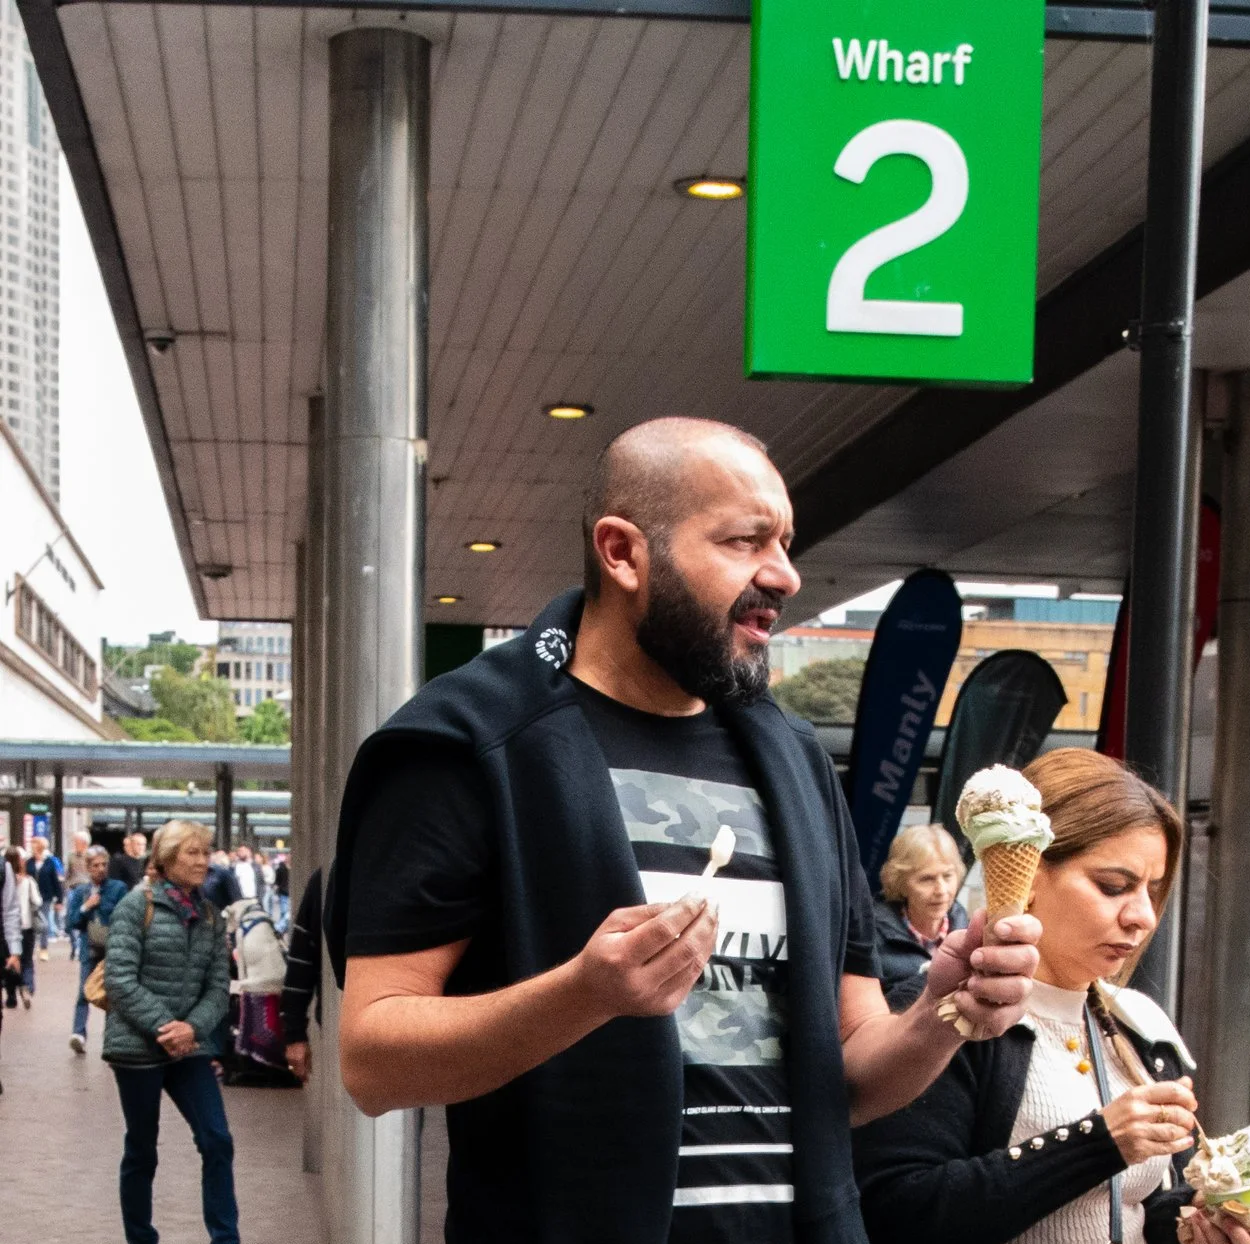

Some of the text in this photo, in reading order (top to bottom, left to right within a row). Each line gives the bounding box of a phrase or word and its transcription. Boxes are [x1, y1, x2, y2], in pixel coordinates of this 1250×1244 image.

[831, 37, 974, 86] Wharf
[826, 118, 970, 337] 2
[871, 669, 937, 804] Manly
